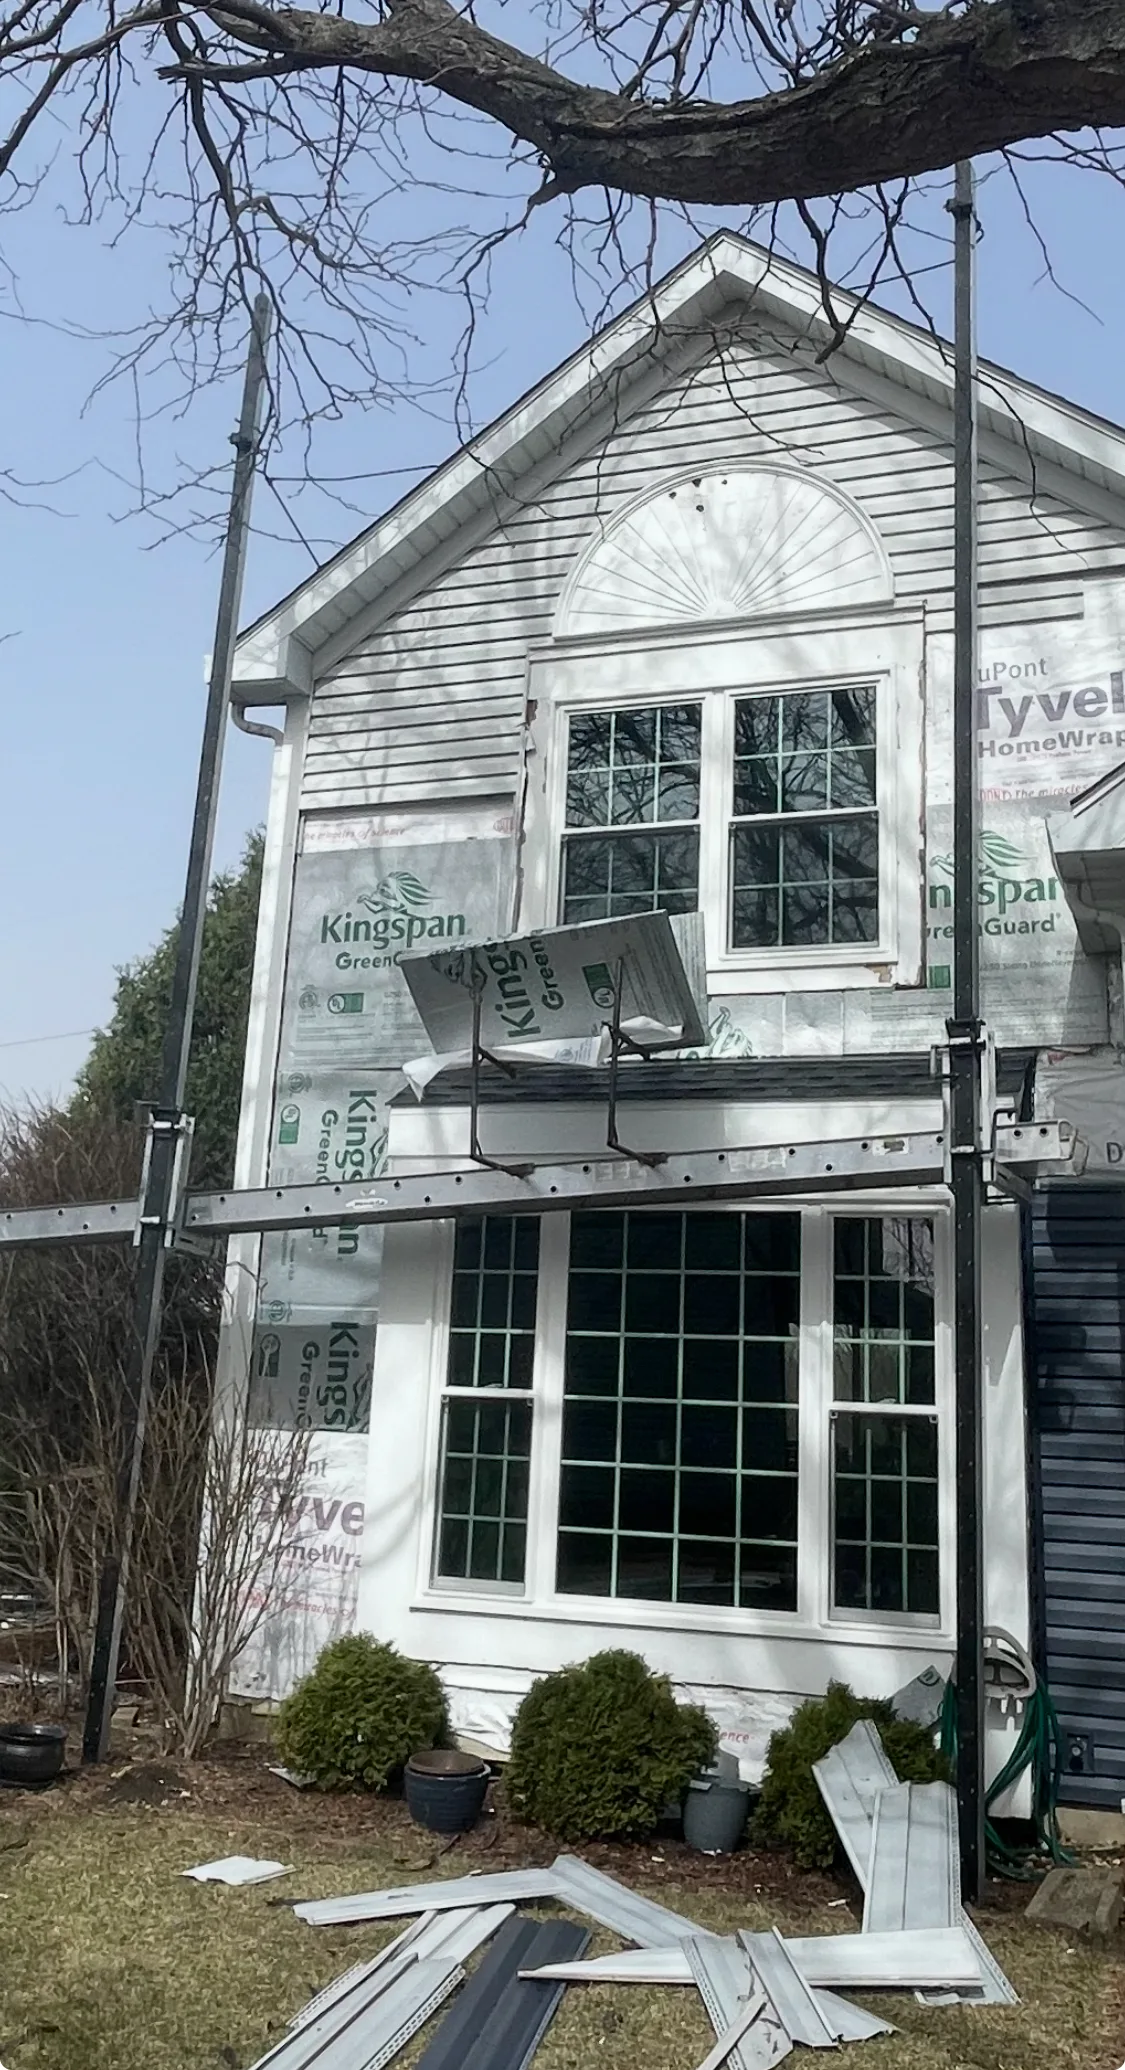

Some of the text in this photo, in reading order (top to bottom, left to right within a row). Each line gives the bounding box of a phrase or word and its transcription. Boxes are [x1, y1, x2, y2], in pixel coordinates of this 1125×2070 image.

[977, 658, 1049, 683] uPont
[320, 911, 467, 951] Kingspan
[720, 1732, 750, 1745] ence
